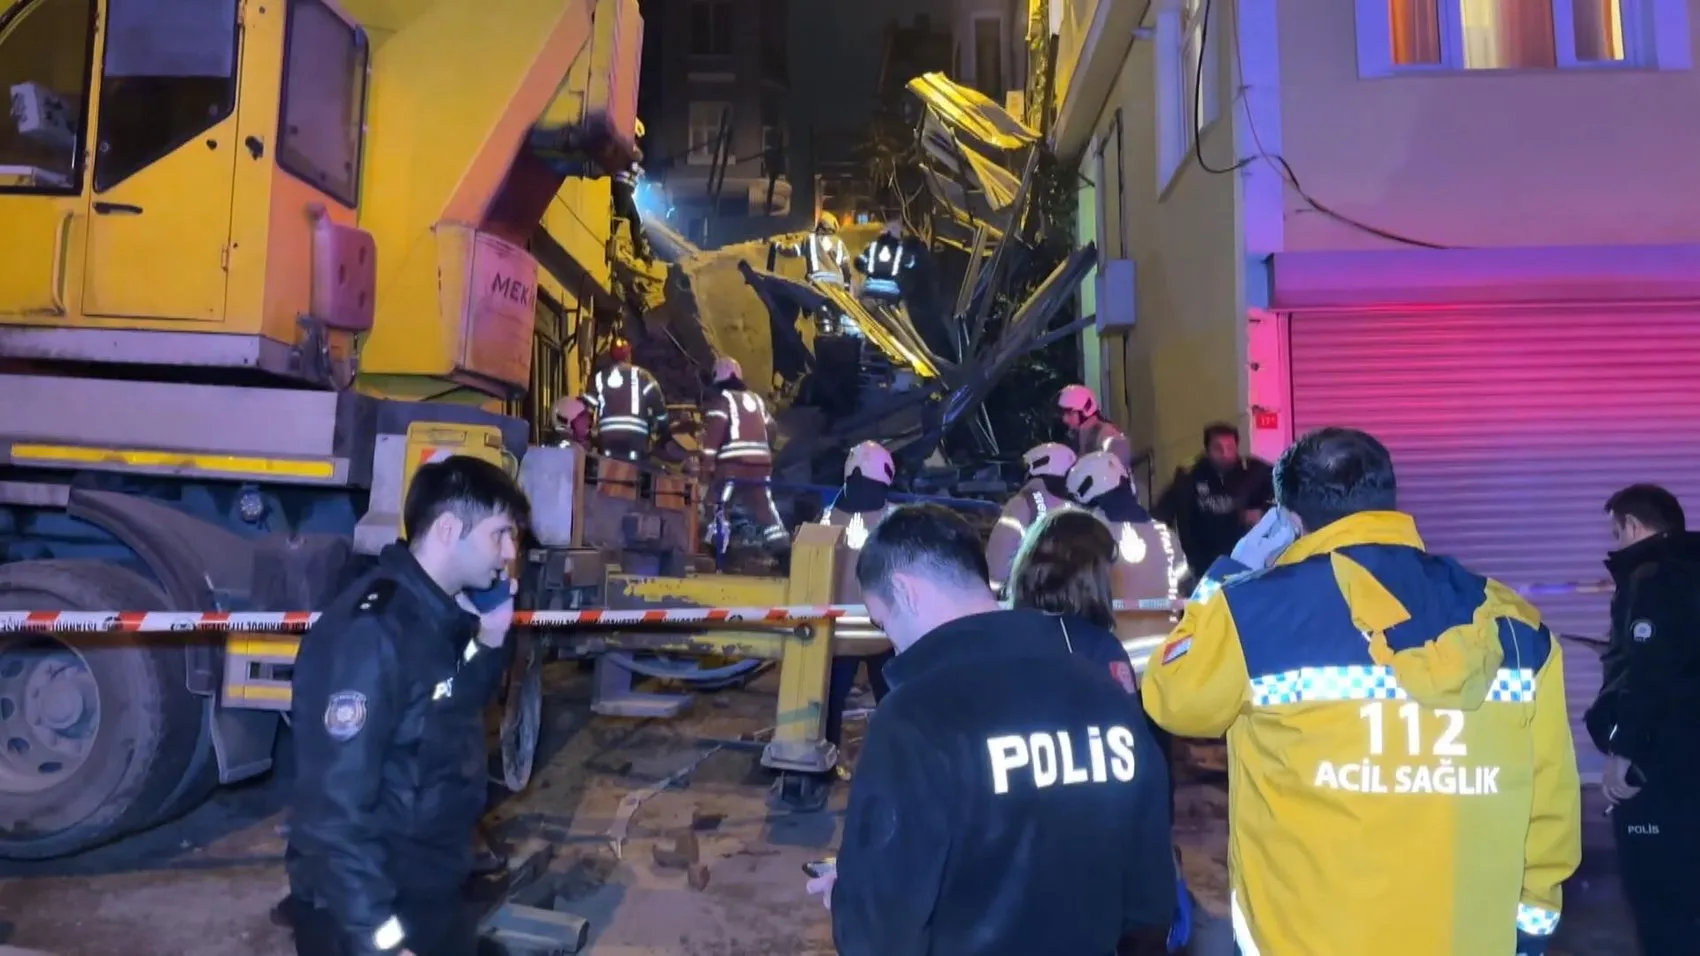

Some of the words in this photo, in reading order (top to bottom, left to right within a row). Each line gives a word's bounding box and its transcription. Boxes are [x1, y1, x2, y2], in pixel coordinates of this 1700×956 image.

[1359, 701, 1468, 757] 112
[986, 725, 1135, 795] POLİS
[1313, 757, 1389, 794] ACİL
[1394, 757, 1500, 796] SAĞLIK
